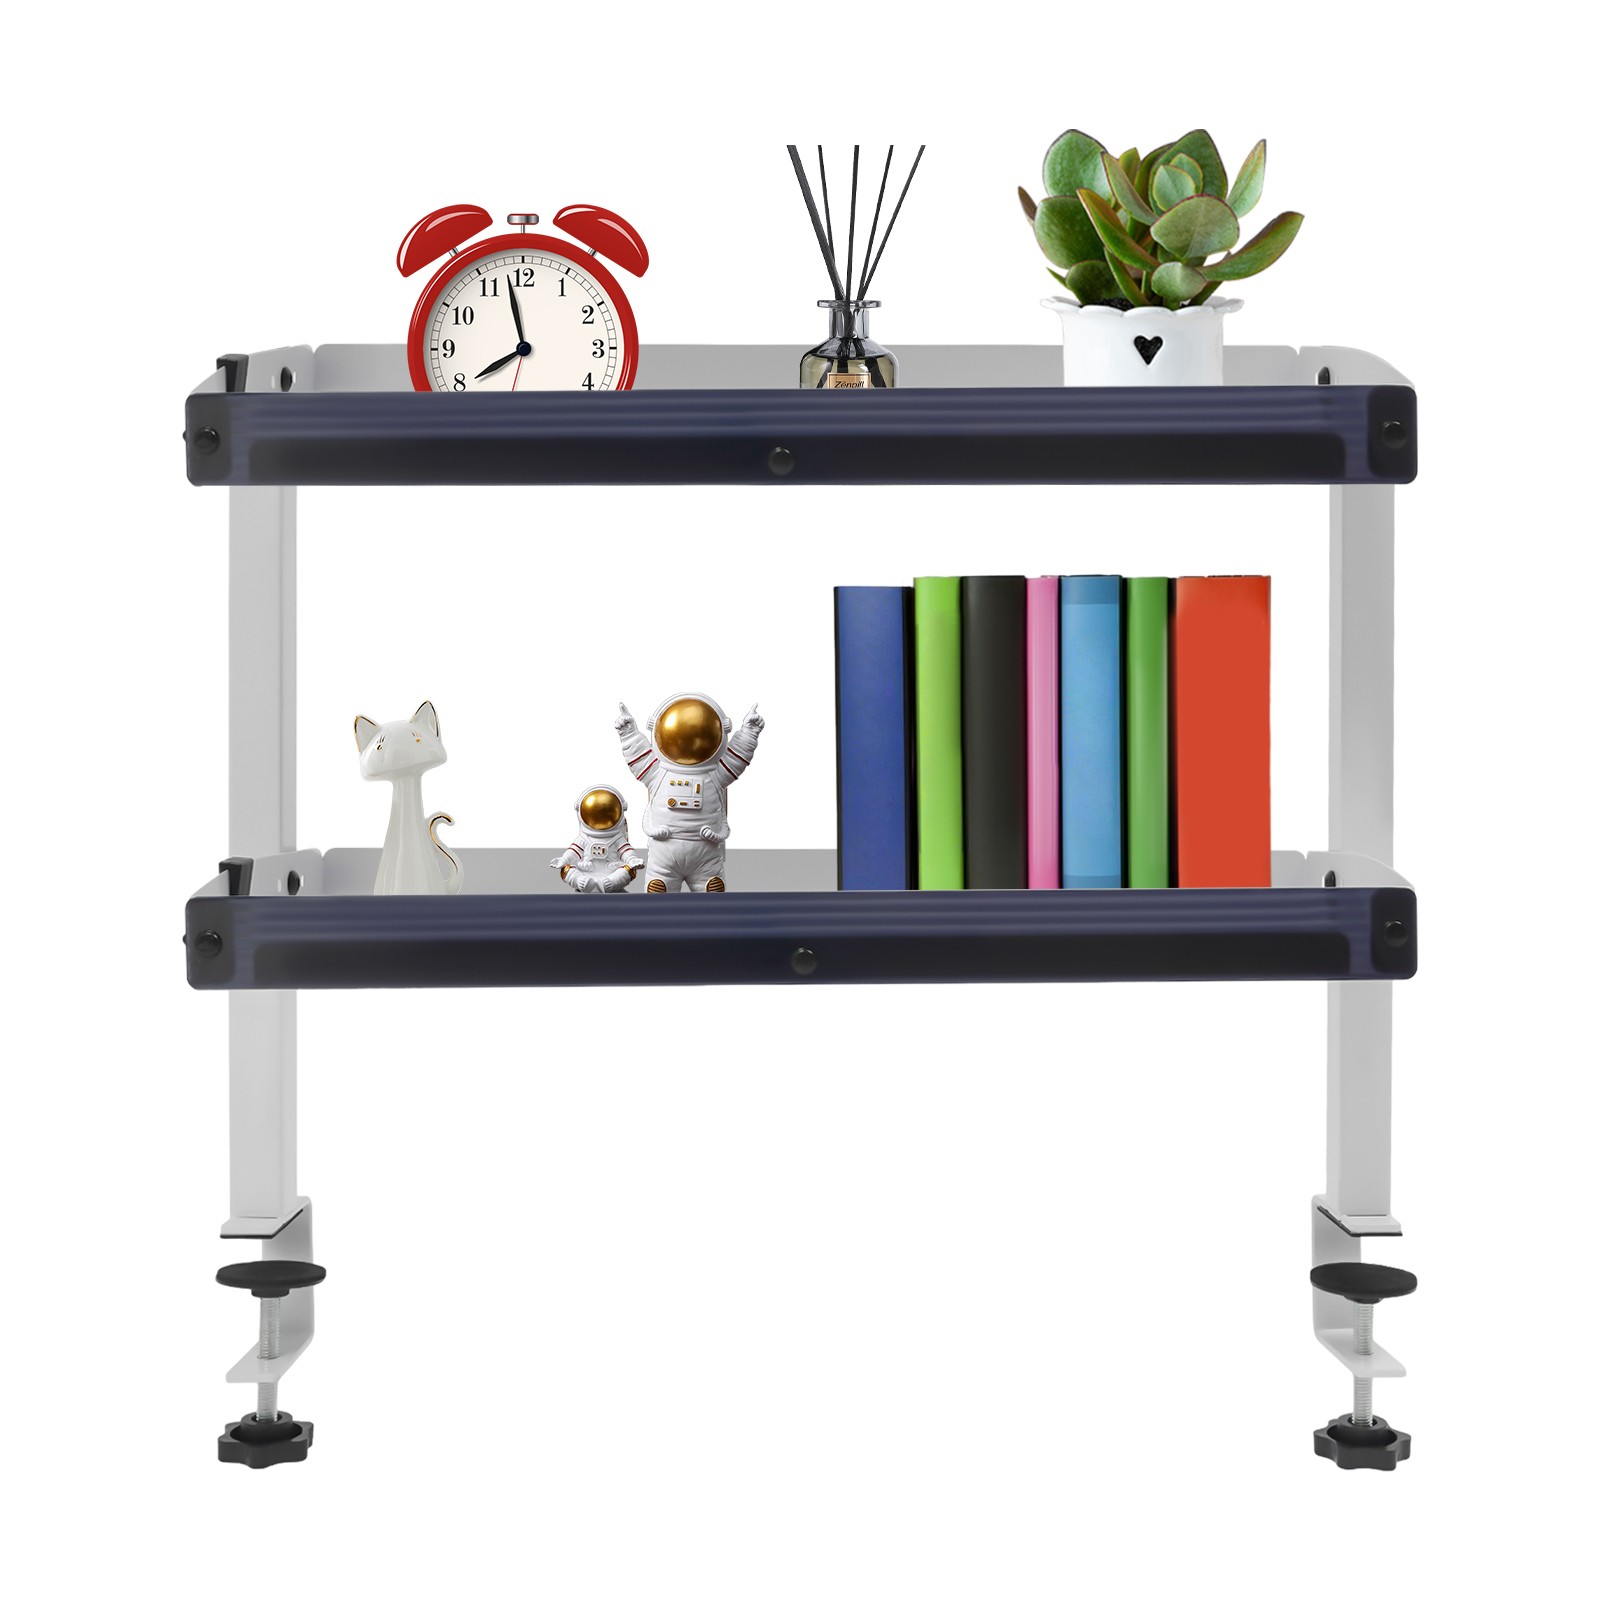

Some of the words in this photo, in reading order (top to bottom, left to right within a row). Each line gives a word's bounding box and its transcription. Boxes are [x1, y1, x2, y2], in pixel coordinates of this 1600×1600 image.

[479, 277, 500, 297] 11
[513, 268, 535, 287] 12
[558, 277, 566, 297] 1
[452, 306, 474, 325] 10
[582, 305, 595, 325] 2
[442, 339, 455, 358] 9
[592, 339, 604, 358] 3
[454, 373, 466, 392] 8
[582, 372, 594, 391] 4
